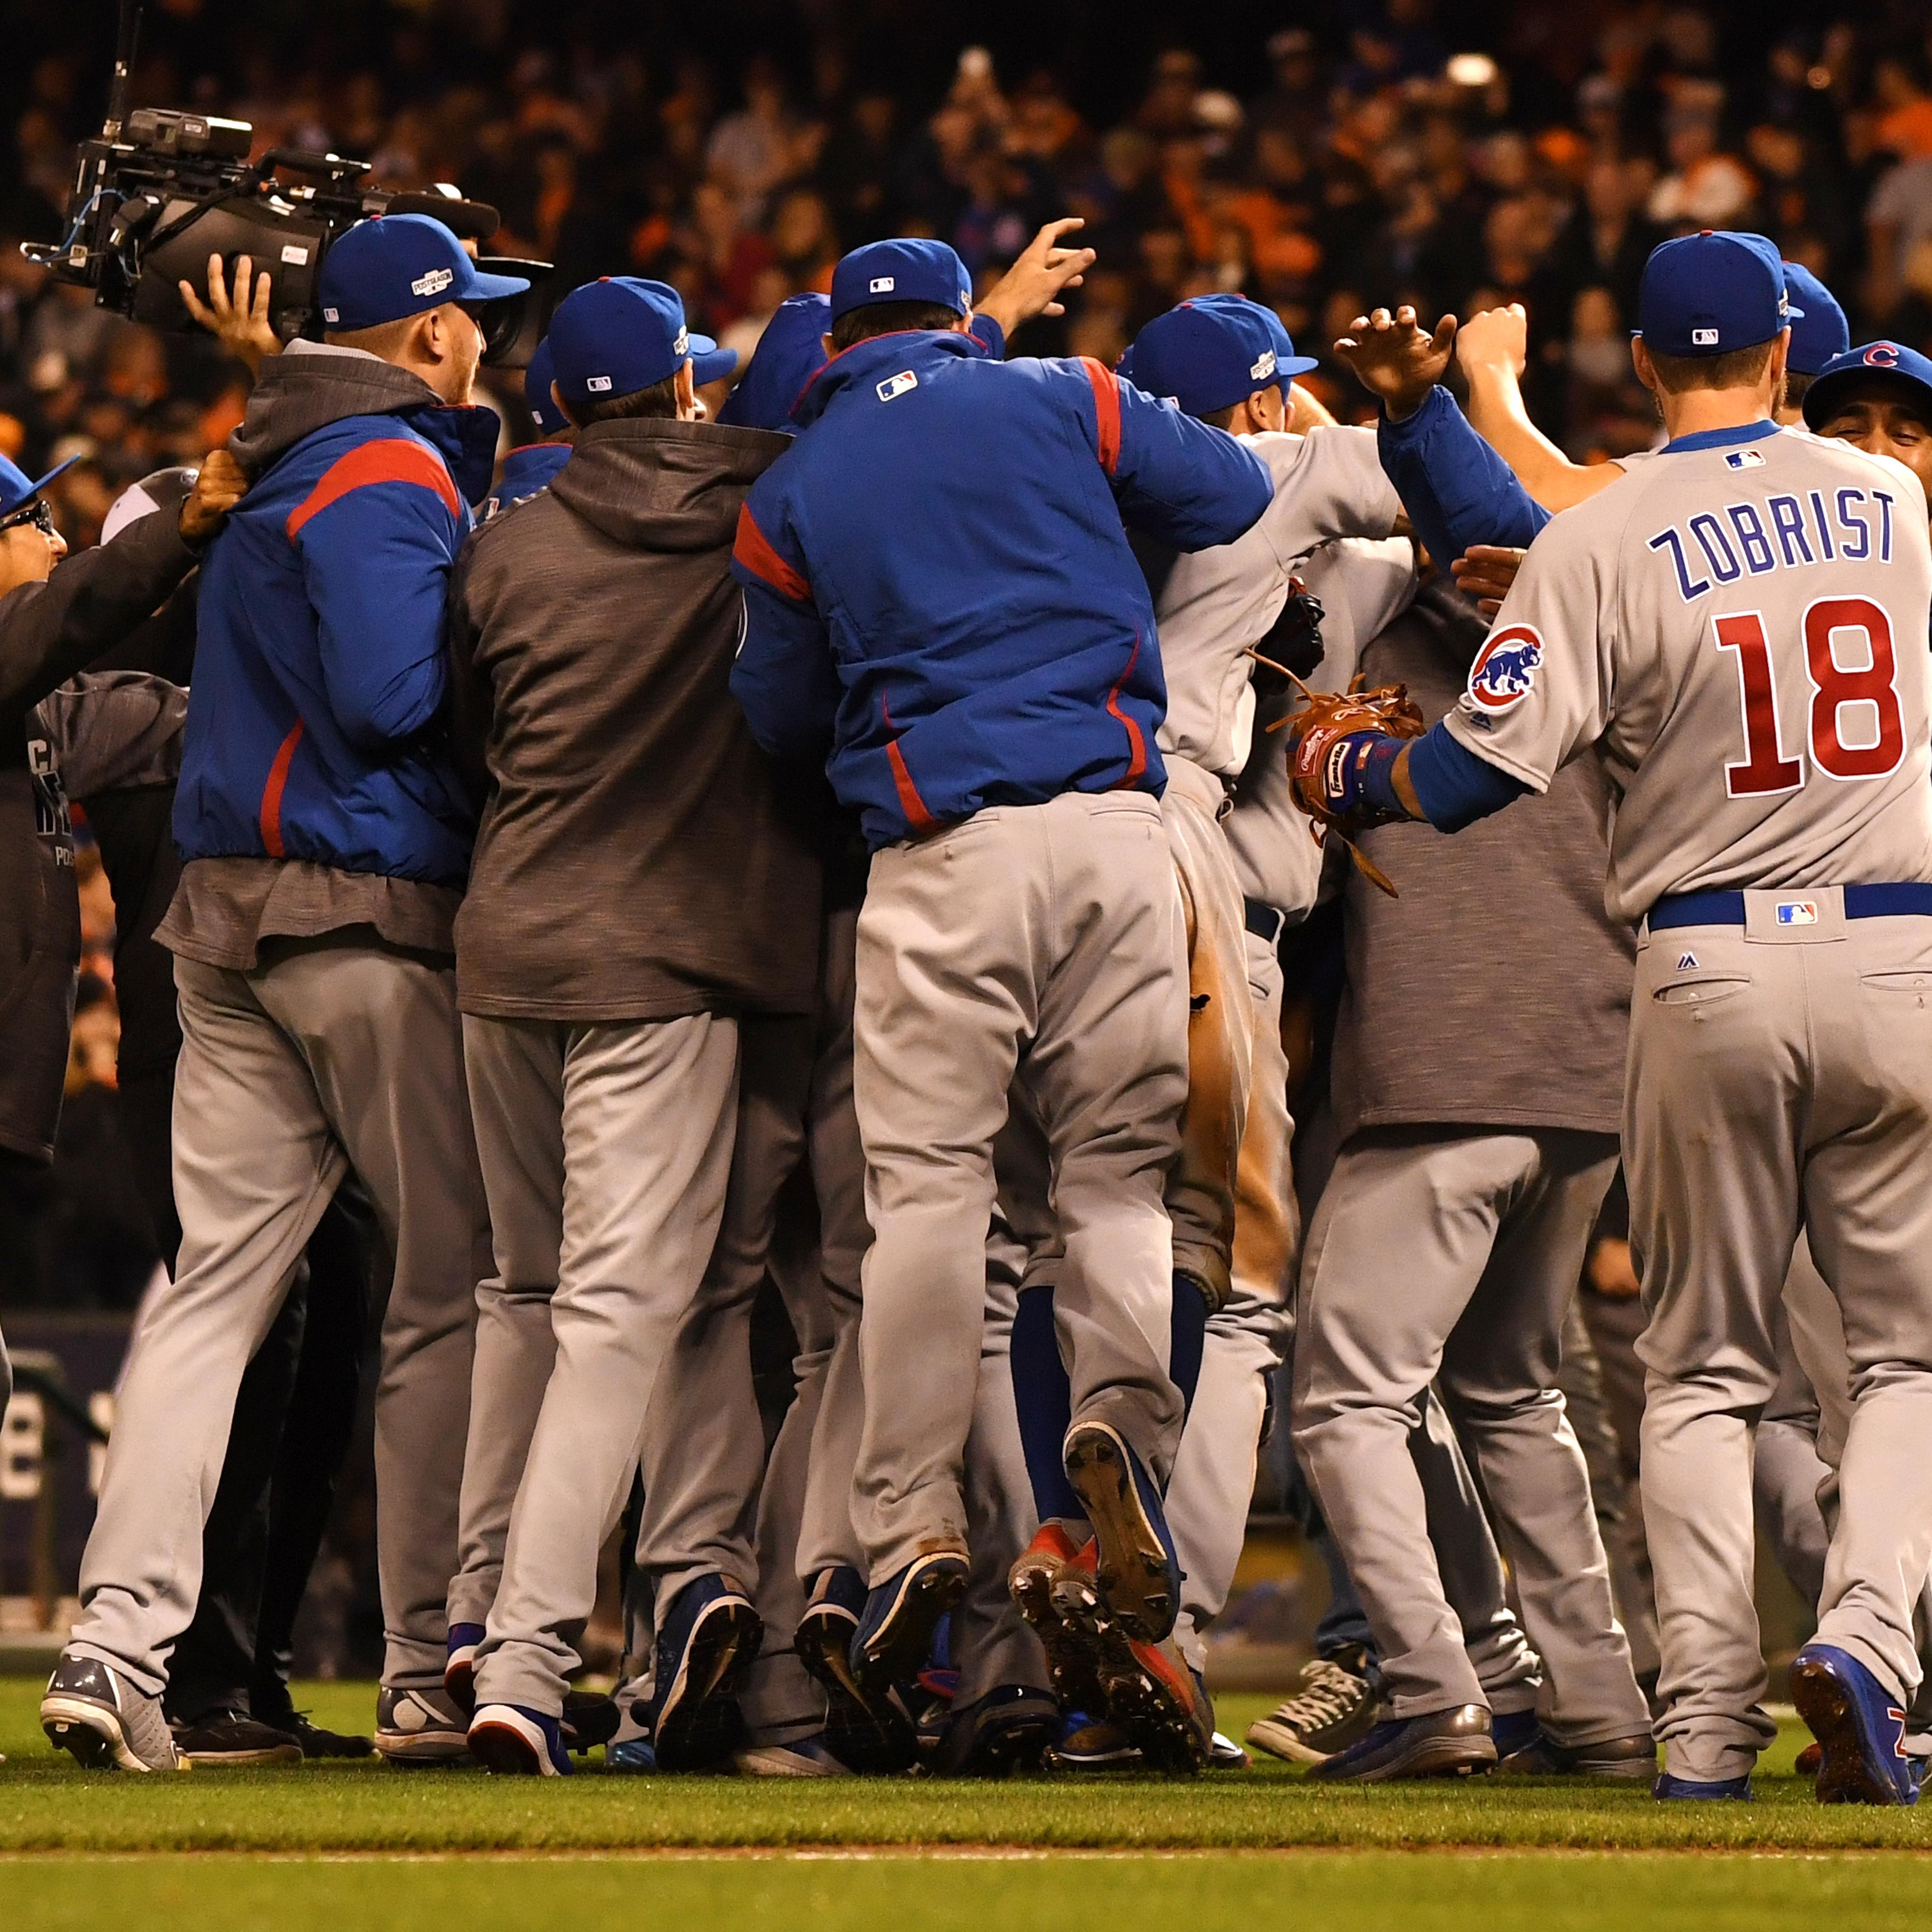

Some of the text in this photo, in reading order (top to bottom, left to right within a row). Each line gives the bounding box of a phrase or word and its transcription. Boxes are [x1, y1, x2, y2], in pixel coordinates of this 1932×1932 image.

[1863, 344, 1899, 367] C
[1646, 487, 1897, 604] ZOBRIST
[1711, 595, 1906, 798] 18
[1331, 745, 1346, 793] Franklin
